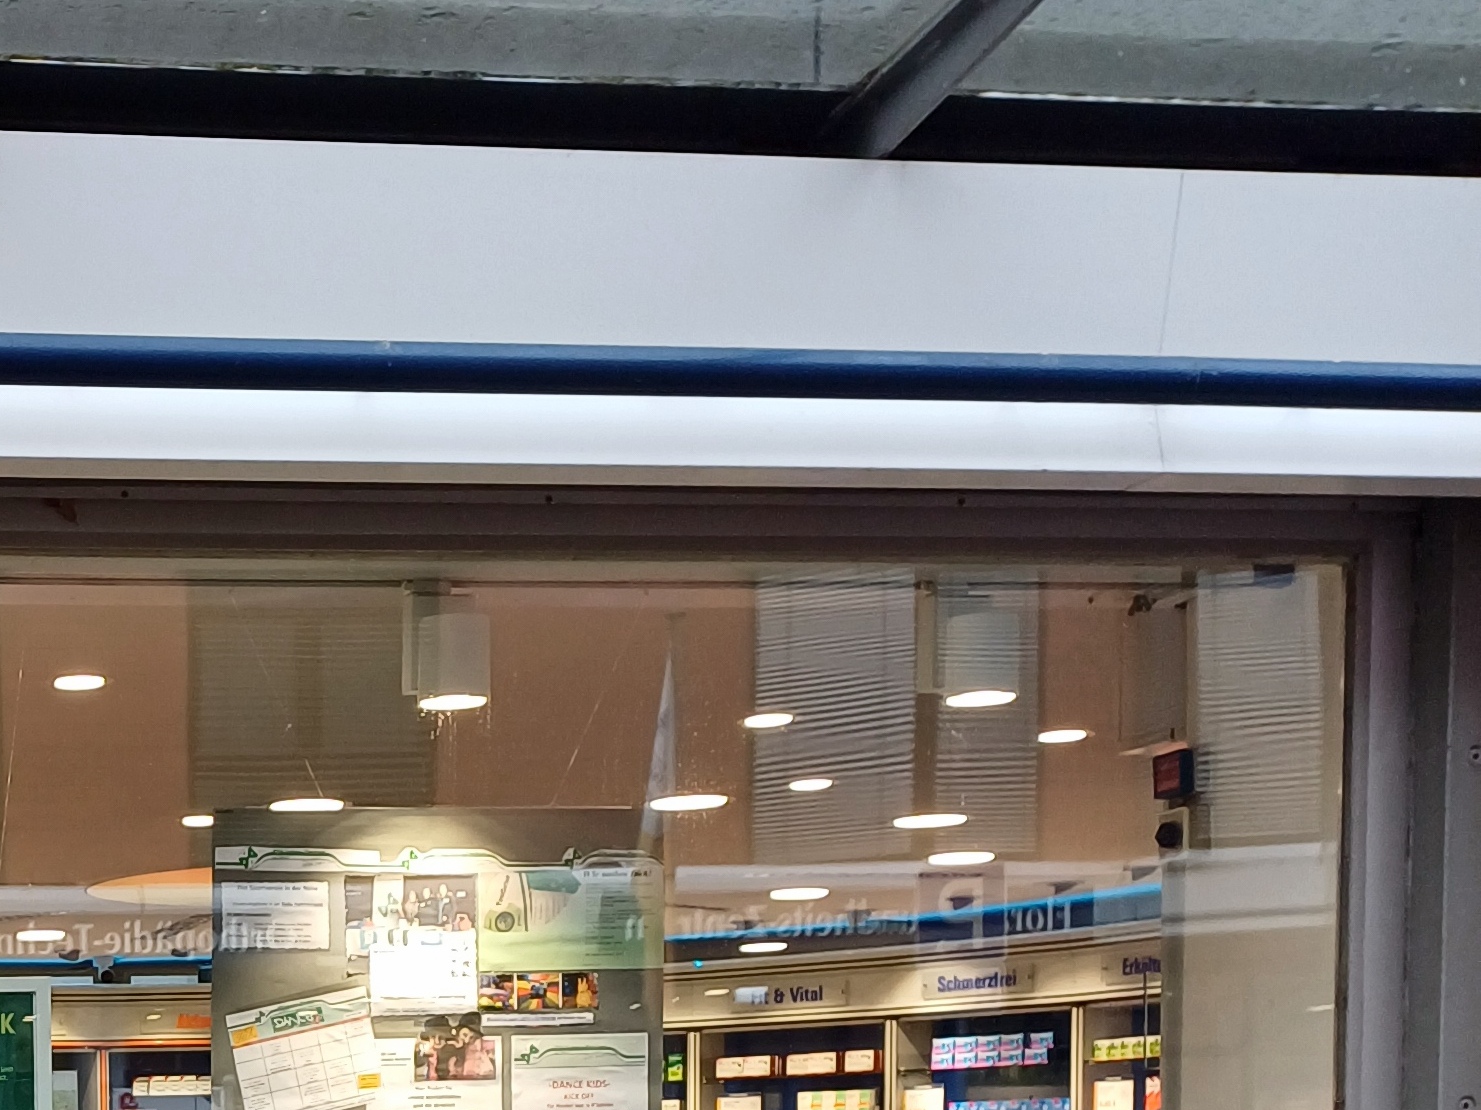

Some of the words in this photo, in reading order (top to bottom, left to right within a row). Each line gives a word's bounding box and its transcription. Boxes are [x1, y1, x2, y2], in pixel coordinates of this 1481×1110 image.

[937, 972, 1018, 993] Schmerzfrei
[773, 988, 785, 1003] &
[789, 985, 823, 1003] Vital
